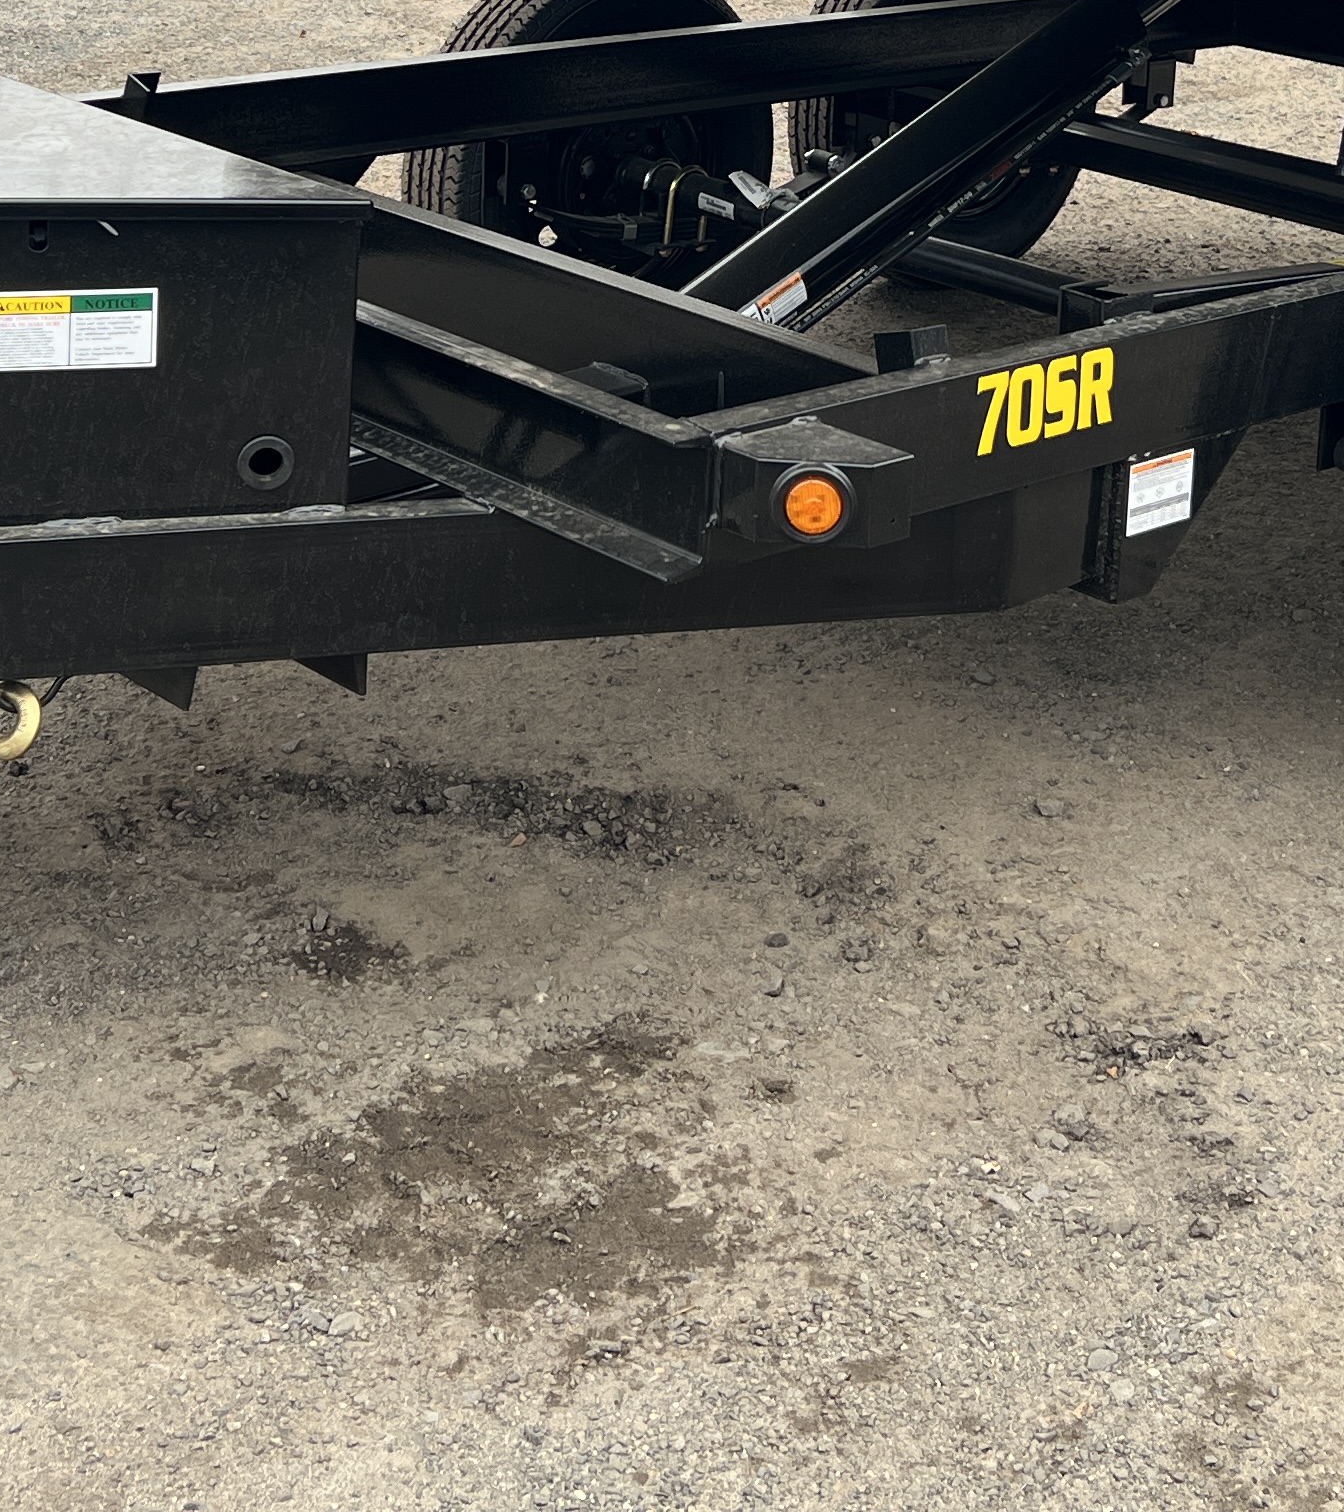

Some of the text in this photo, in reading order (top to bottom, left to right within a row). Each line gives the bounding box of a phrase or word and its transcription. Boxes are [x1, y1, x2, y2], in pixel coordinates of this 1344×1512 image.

[6, 301, 64, 311] CAUTION
[84, 298, 139, 309] NOTICE
[977, 347, 1114, 457] 70SR
